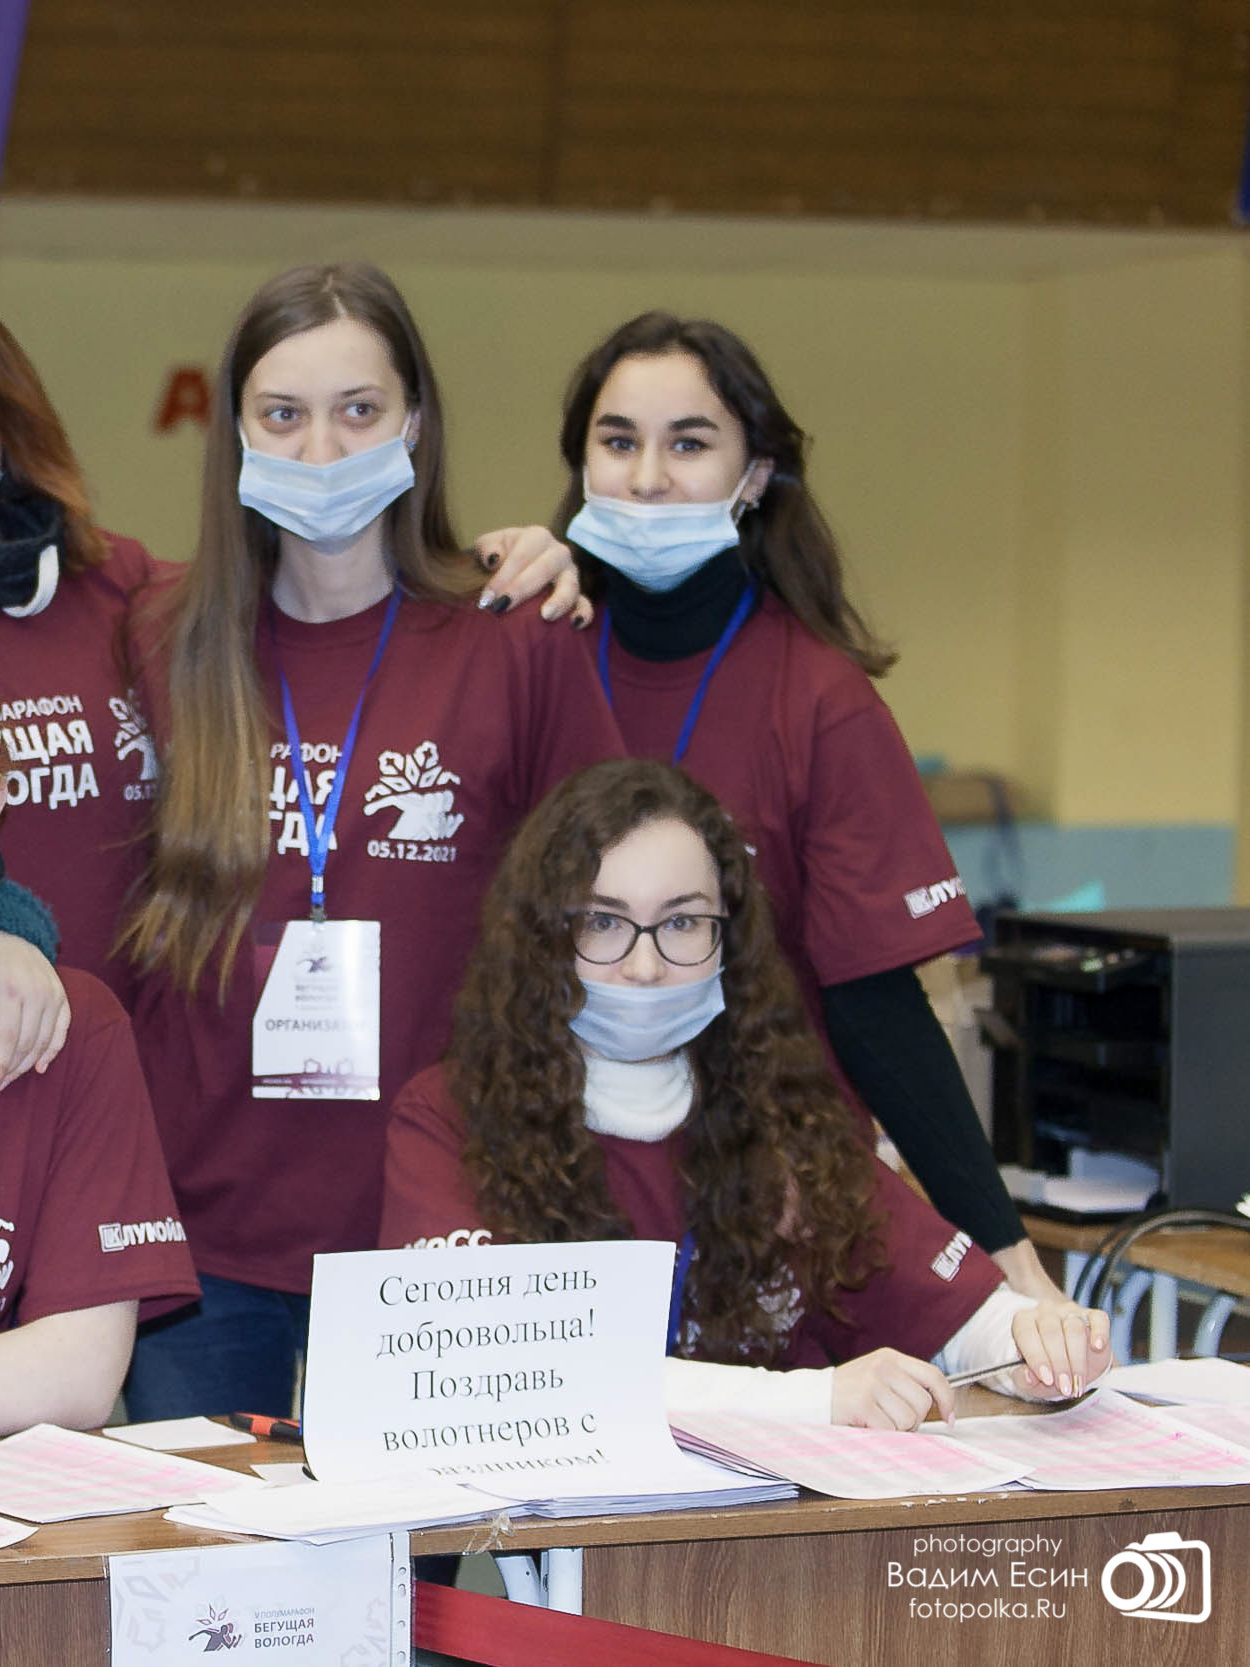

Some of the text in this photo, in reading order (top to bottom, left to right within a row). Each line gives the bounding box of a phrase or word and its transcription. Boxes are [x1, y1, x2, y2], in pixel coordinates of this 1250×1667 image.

[367, 840, 456, 863] 05.12.2021
[379, 1268, 598, 1306] Сегодня день
[376, 1307, 597, 1358] добровольца!
[410, 1367, 565, 1402] Поздравь
[383, 1412, 598, 1451] волотнеров с
[254, 1617, 314, 1633] БЕГУЩАЯ
[254, 1633, 314, 1649] ВОЛОГДА
